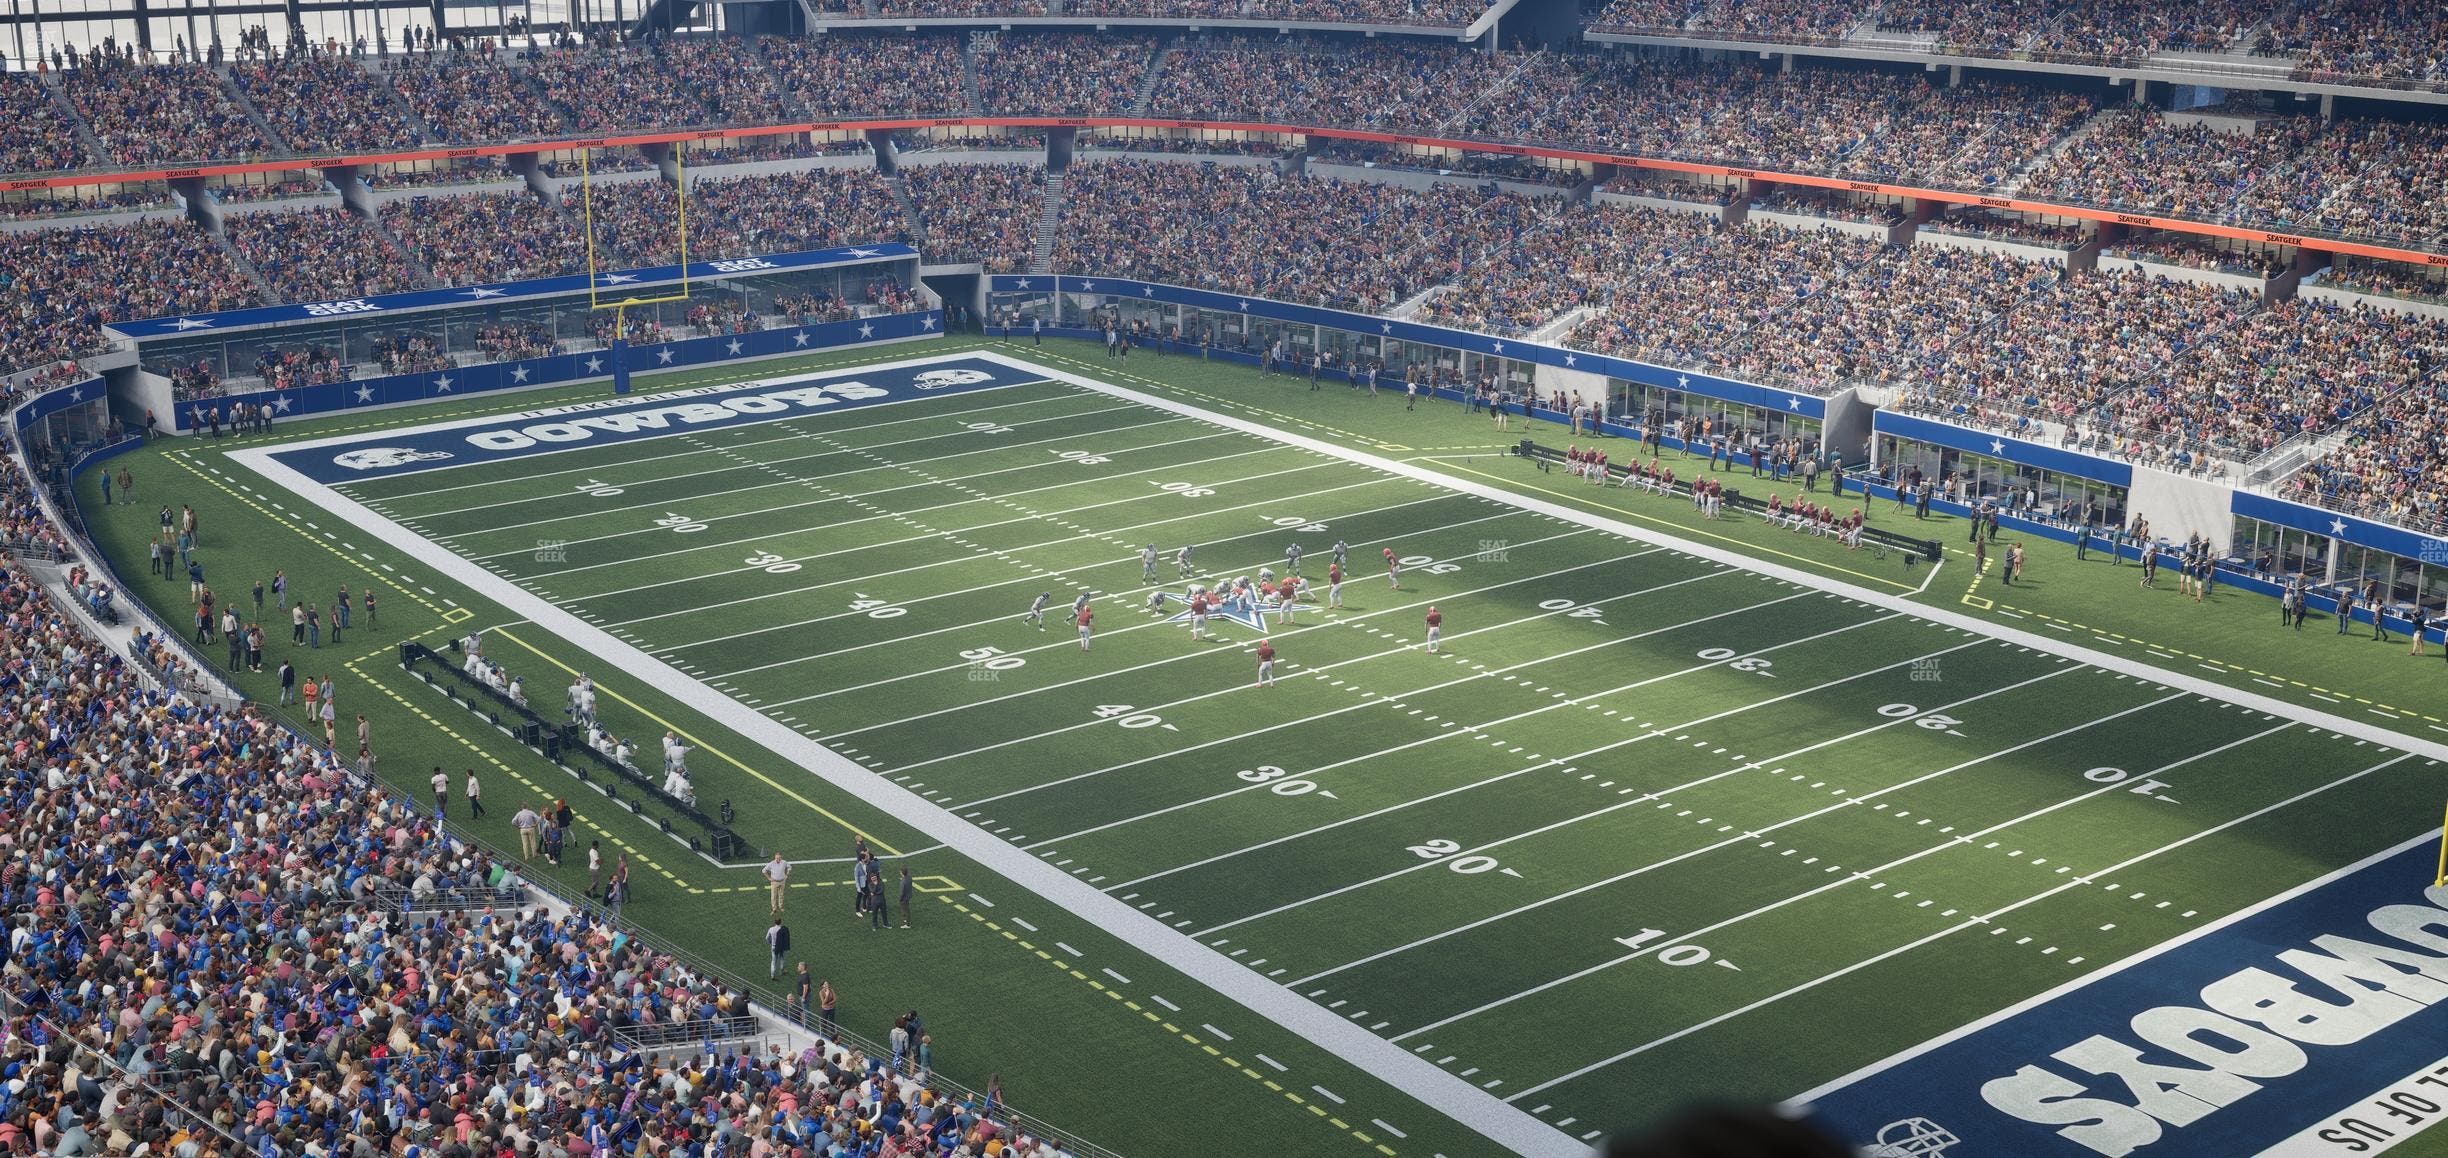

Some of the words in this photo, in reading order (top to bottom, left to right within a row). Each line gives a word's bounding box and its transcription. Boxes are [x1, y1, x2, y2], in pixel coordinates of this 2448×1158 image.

[310, 158, 344, 167] SEATGEEK
[166, 169, 200, 178] SEATGEEK
[1728, 169, 1755, 178] SEATGEEK
[11, 180, 48, 190] SEATGEEK
[1850, 183, 1879, 193] SEATGEEK
[1980, 197, 2011, 208] SEATGEEK
[2118, 215, 2151, 226] SEATGEEK
[2266, 234, 2302, 246] SEATGEEK
[303, 299, 365, 311] SEAT
[309, 304, 384, 315] GEEK
[552, 399, 633, 414] TAKES
[642, 392, 685, 401] ALL
[694, 386, 722, 395] OF
[730, 381, 761, 389] US
[465, 381, 889, 450] COWBOYS
[967, 422, 1014, 434] 10
[575, 482, 624, 497] 10
[1161, 482, 1217, 497] 30
[653, 516, 709, 533] 20
[1273, 516, 1328, 531] 40
[744, 554, 803, 574] 30
[1398, 556, 1462, 575] 50
[848, 598, 908, 619] 40
[1538, 599, 1604, 618] 40
[959, 646, 1026, 670] 50
[1697, 648, 1773, 671] 30
[1092, 704, 1162, 728] 40
[1877, 702, 1963, 729] 20
[1237, 765, 1317, 796] 30
[2083, 767, 2173, 795] 10
[1404, 838, 1498, 874] 20
[1612, 927, 1710, 966] 10
[2374, 1092, 2441, 1126] OF
[2318, 1118, 2396, 1152] US
